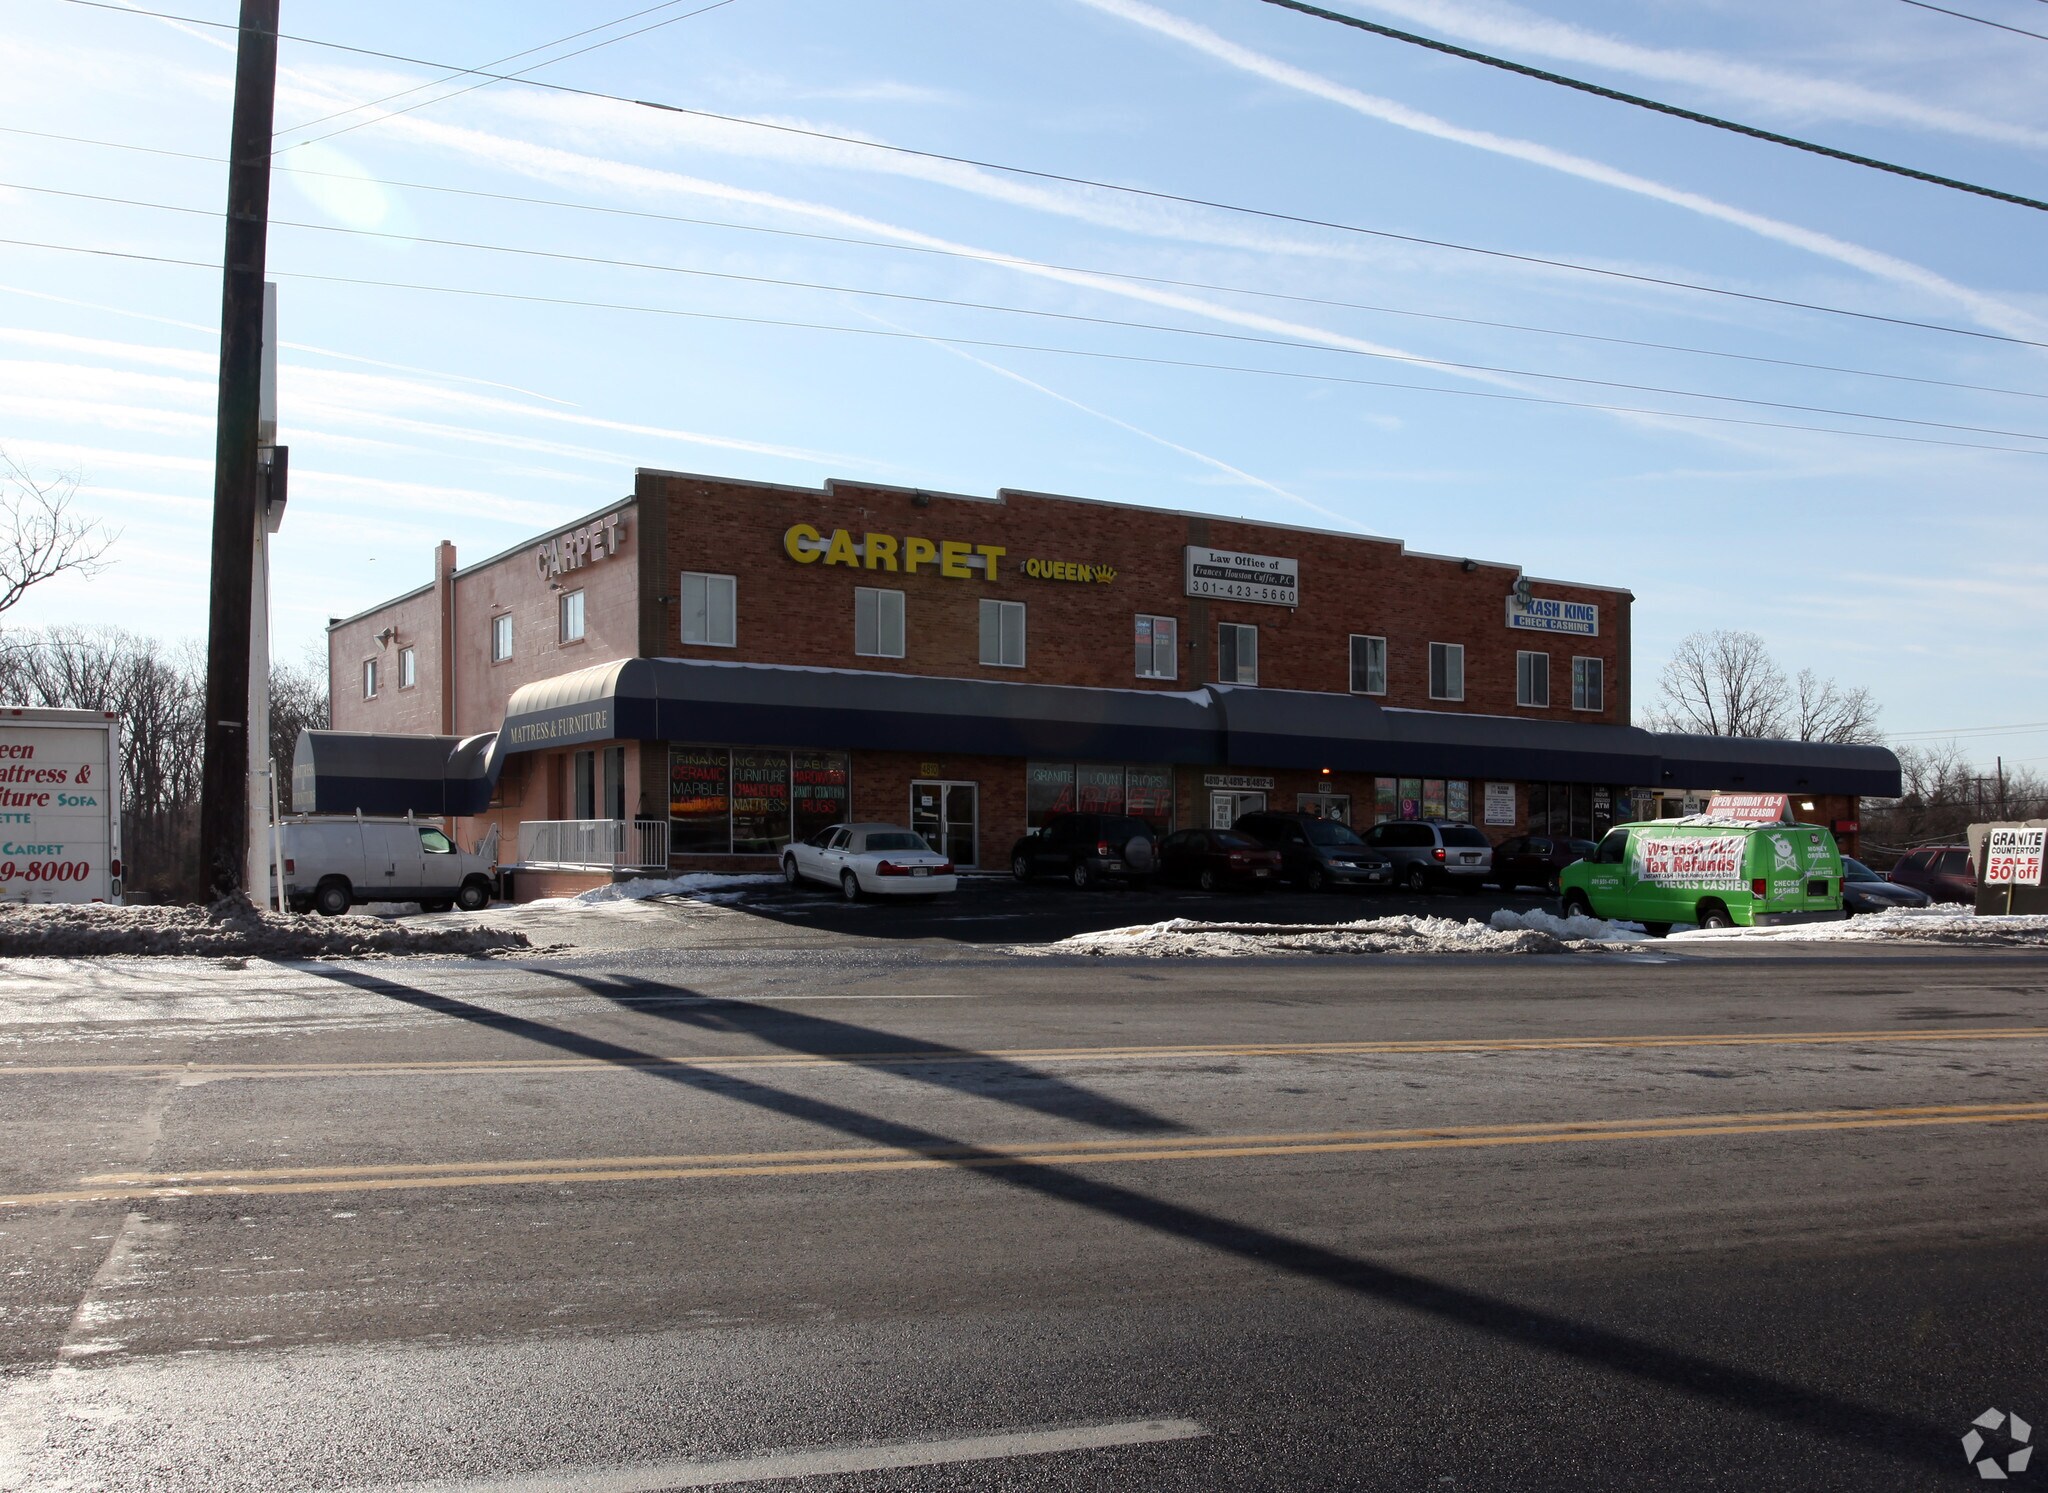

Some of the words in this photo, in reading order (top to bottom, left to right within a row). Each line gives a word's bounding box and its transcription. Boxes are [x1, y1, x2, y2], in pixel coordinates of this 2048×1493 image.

[536, 513, 619, 581] CARPET
[784, 523, 1006, 581] CARPET
[1209, 553, 1231, 564] Law
[1235, 556, 1265, 568] Office
[1270, 561, 1279, 569] of
[1026, 558, 1090, 582] QUEEN
[1195, 565, 1222, 577] Frances
[1225, 569, 1251, 579] Houston
[1193, 581, 1294, 601] 301-423-5660
[1527, 600, 1560, 617] KASH
[1565, 604, 1594, 621] KING
[1519, 617, 1548, 628] CHECK
[1551, 620, 1589, 632] CASHING
[510, 721, 549, 744] MATTRESS
[550, 724, 557, 738] &
[558, 710, 608, 736] FURNITURE
[75, 764, 91, 784] &
[672, 766, 725, 780] CERAMIC
[734, 768, 785, 783] FURNITURE
[1033, 769, 1074, 783] GRANITE
[673, 782, 725, 796] MARBLE
[734, 798, 788, 812] MATTRESS
[802, 799, 837, 813] RUGS
[1712, 797, 1730, 806] OPEN
[1732, 797, 1762, 806] SUNDAY
[1764, 797, 1782, 806] 10-4
[1750, 809, 1776, 817] SEASON
[1993, 832, 2043, 846] GRANITE
[1647, 842, 1668, 856] We
[1646, 857, 1668, 872] Tax
[1673, 856, 1735, 872] Refunds
[2018, 866, 2038, 879] off
[1655, 880, 1698, 889] CHECKS
[1702, 881, 1750, 891] CASHED
